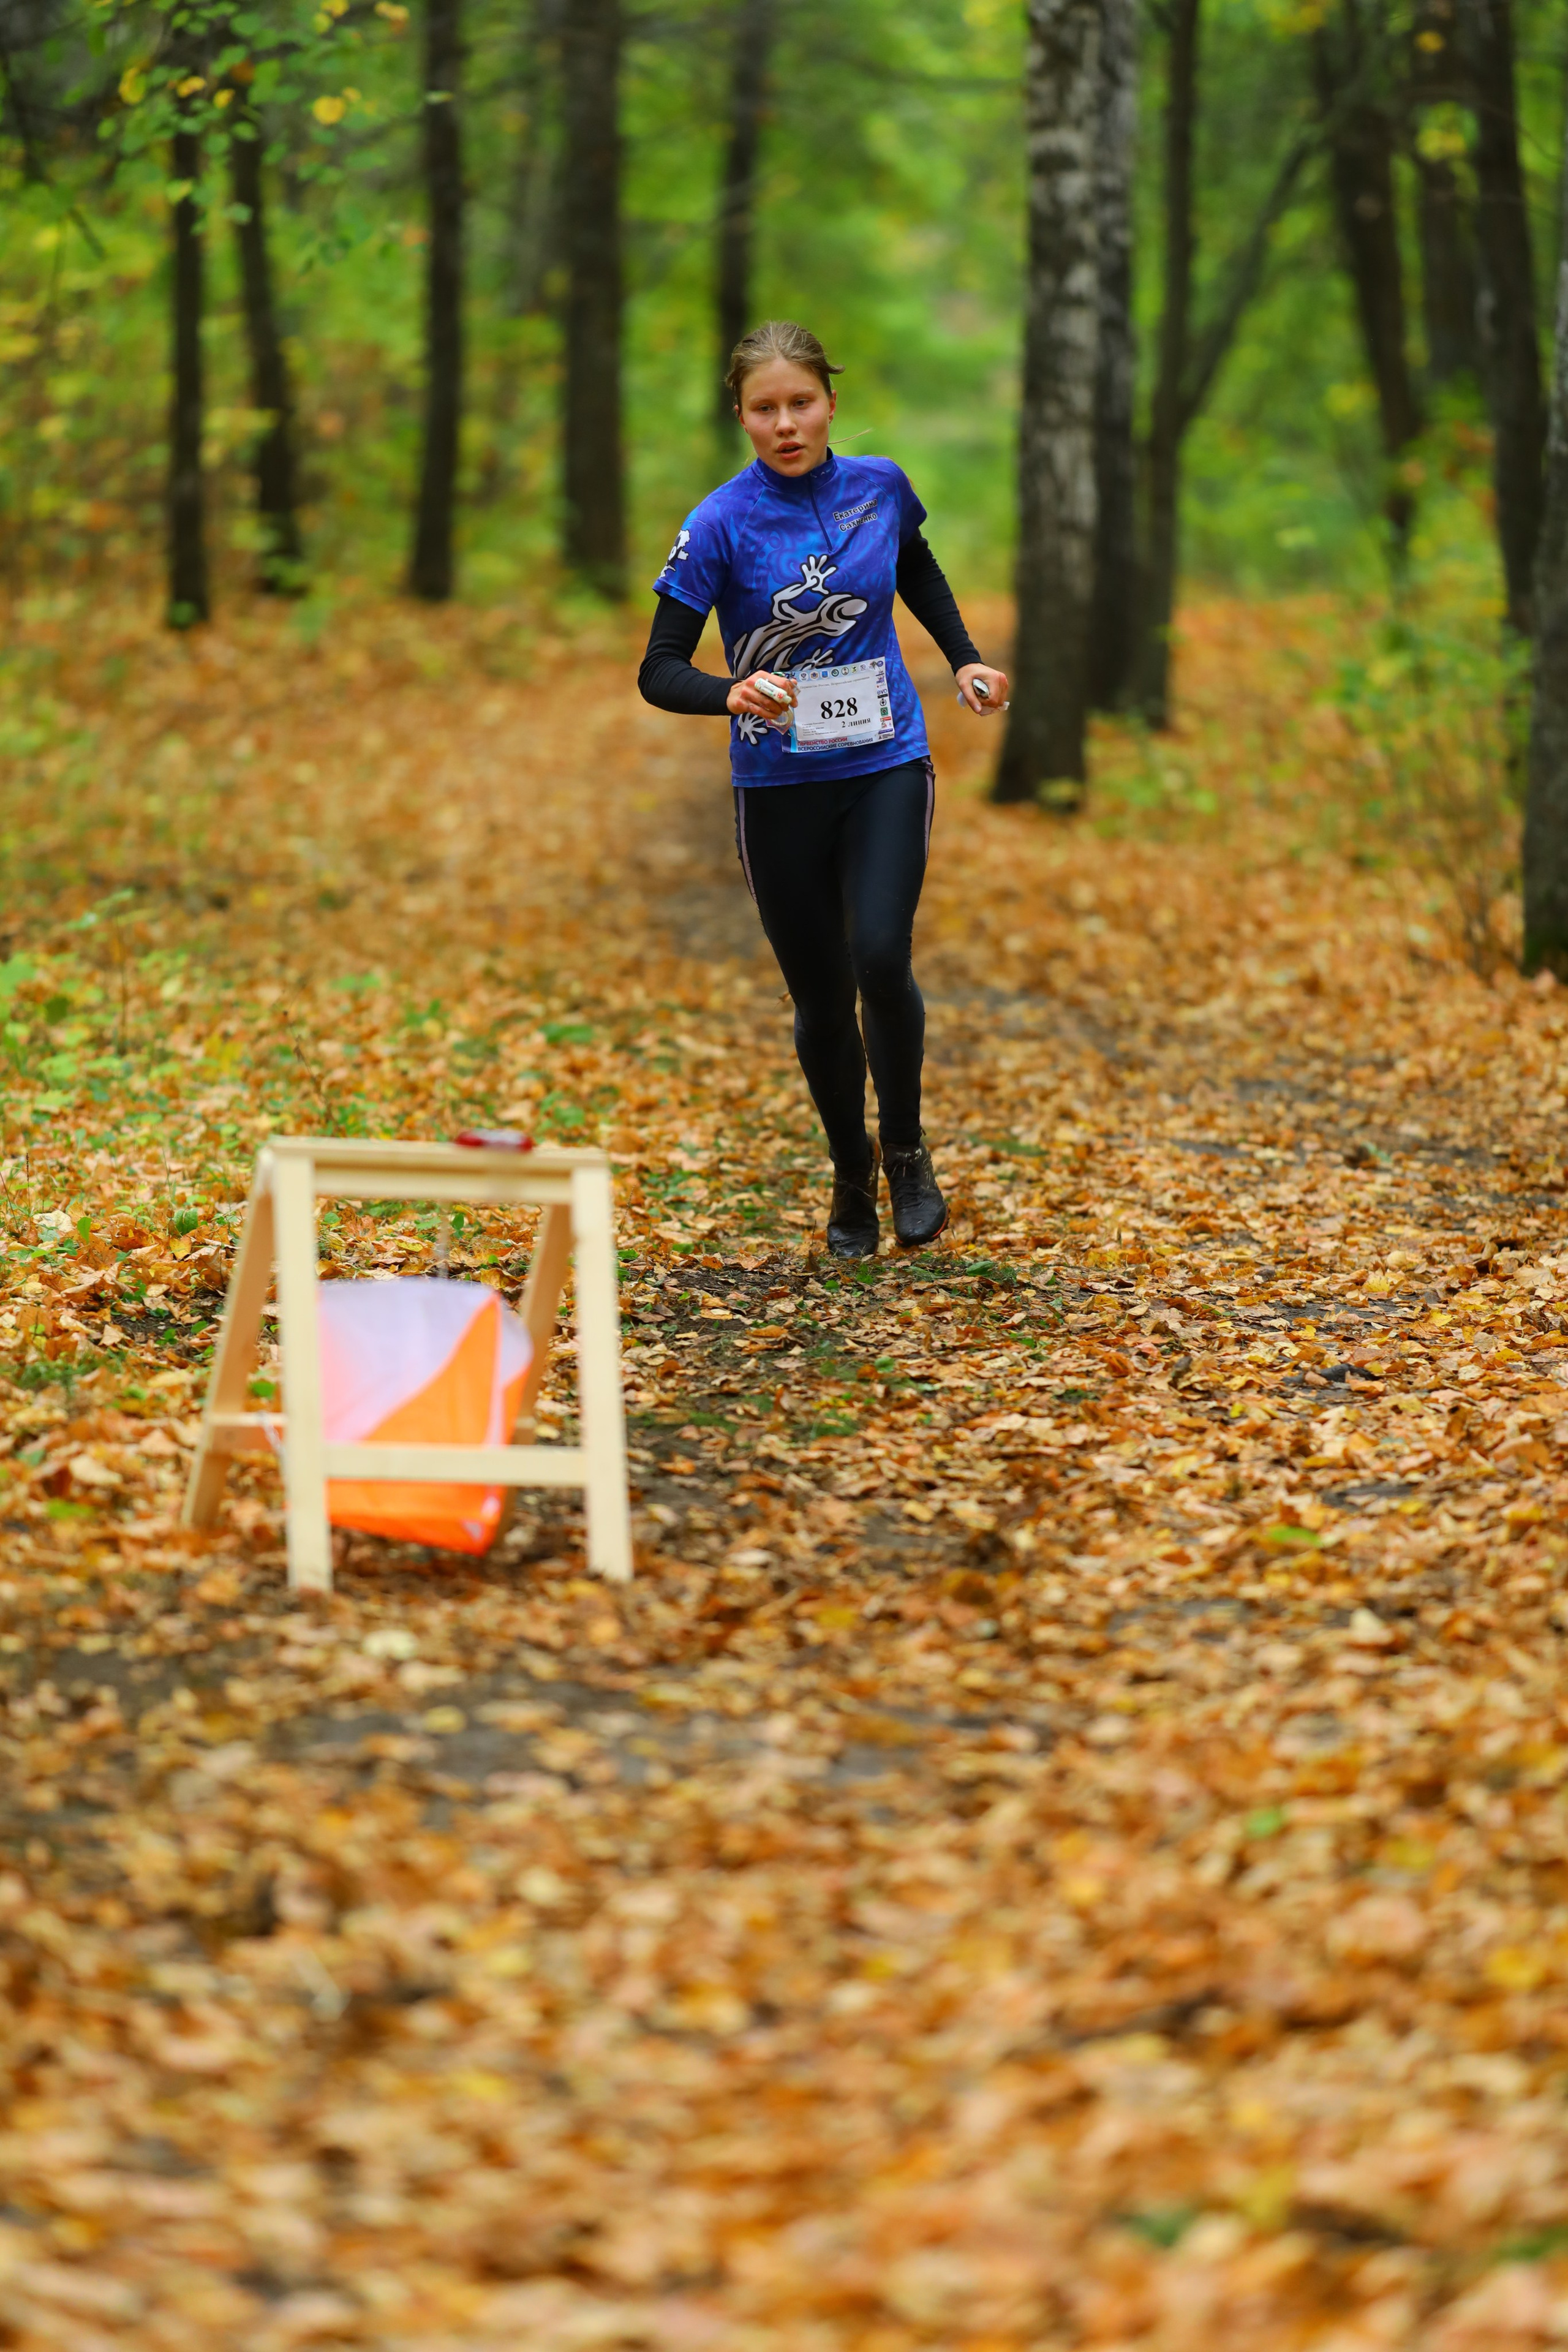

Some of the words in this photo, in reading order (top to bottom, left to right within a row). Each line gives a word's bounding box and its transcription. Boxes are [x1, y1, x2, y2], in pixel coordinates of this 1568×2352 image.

[833, 499, 877, 521] Екатерина
[839, 513, 877, 532] Сахненко
[821, 697, 858, 719] 828
[848, 718, 871, 727] линия
[797, 742, 837, 751] ВСЕРОССИЙСКИЕ
[838, 737, 873, 747] СОРЕВНОВАНИЯ
